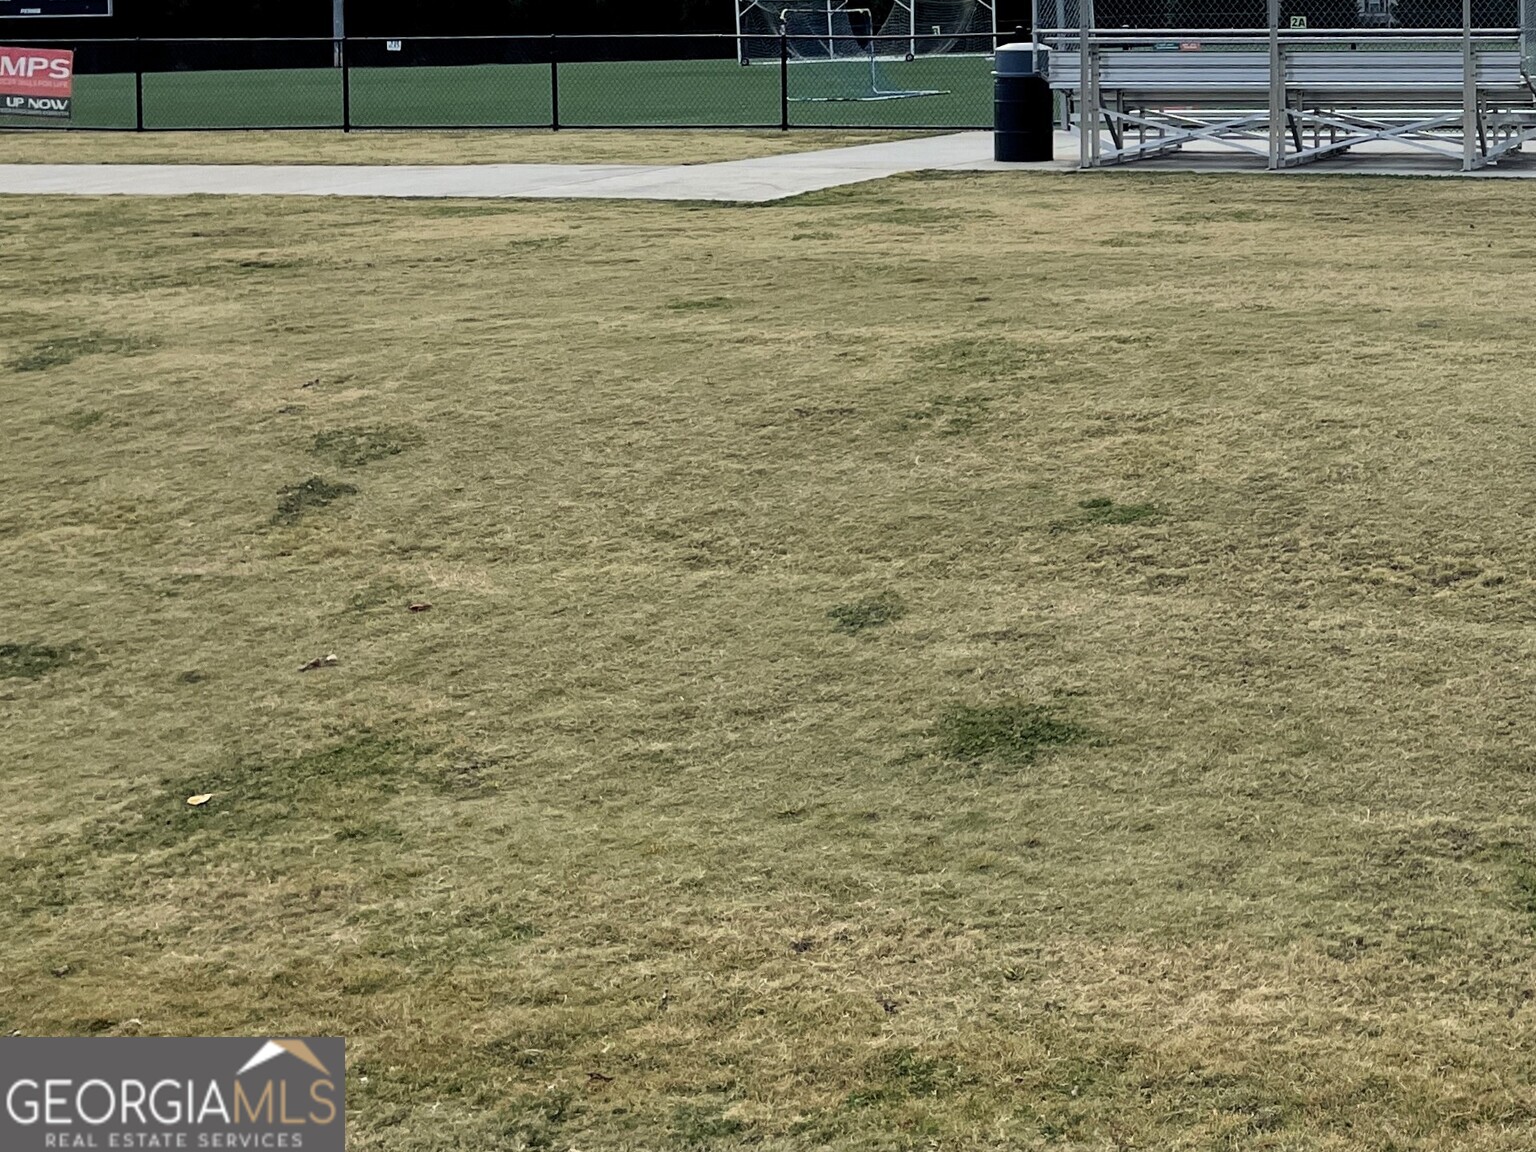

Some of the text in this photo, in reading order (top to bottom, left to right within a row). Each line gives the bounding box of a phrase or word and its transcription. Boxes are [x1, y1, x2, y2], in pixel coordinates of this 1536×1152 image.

[1292, 17, 1305, 27] 2A
[6, 97, 68, 110] UP NOW
